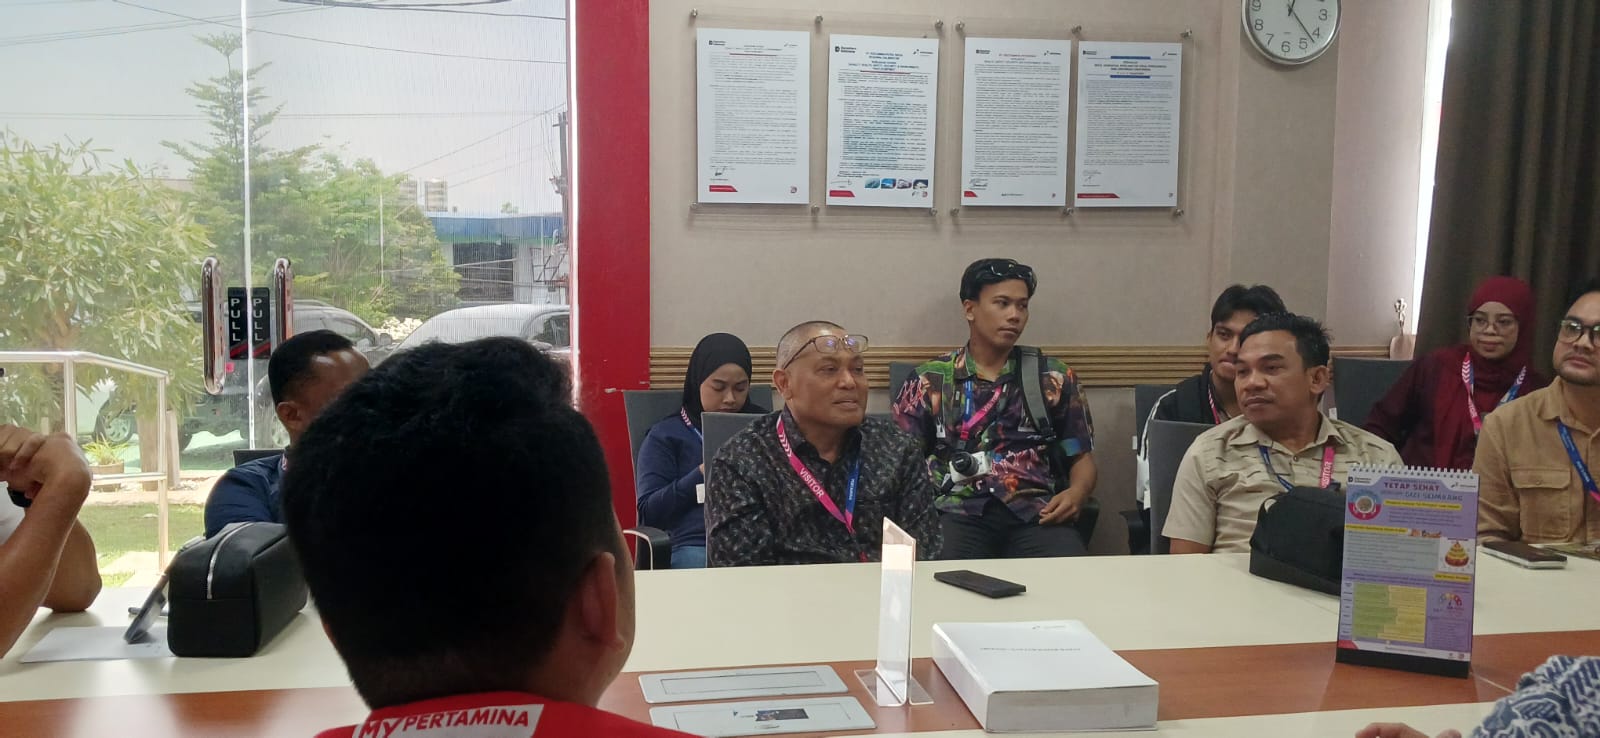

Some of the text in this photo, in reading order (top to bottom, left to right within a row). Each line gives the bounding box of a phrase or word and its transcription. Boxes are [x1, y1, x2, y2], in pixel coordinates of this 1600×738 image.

[1252, 0, 1262, 12] 9
[1318, 8, 1328, 21] 3
[1254, 18, 1264, 31] 8
[1265, 33, 1275, 46] 7
[1312, 27, 1320, 39] 4
[1281, 40, 1291, 53] 6
[1298, 37, 1308, 50] 5
[231, 298, 241, 341] PULL
[253, 298, 263, 341] PULL
[799, 467, 825, 498] VISITOR
[1383, 481, 1411, 490] TETAP
[1413, 483, 1440, 492] SEHAT
